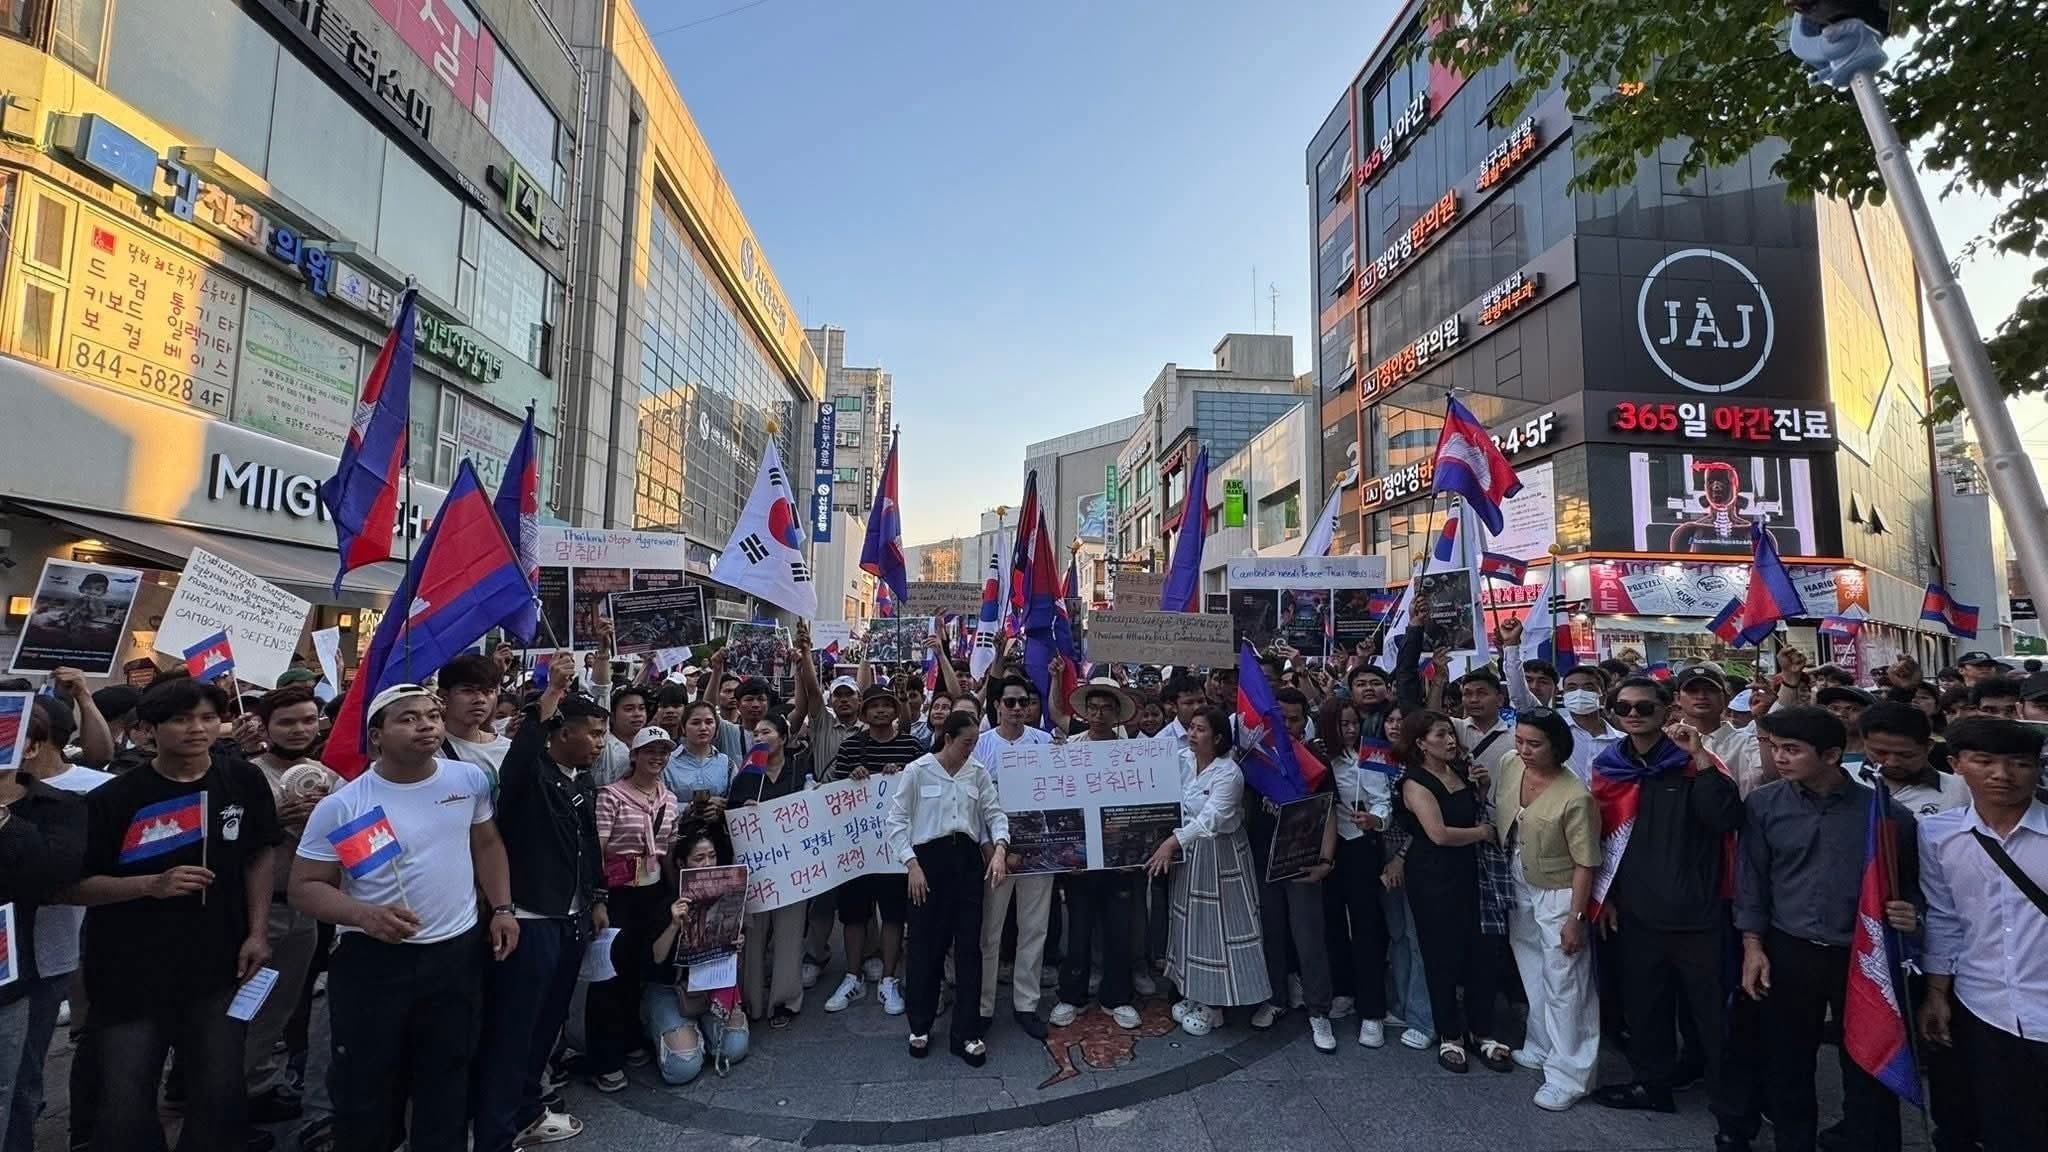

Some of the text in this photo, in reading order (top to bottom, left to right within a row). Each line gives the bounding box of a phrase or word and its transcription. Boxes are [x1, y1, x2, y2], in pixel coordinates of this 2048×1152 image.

[1396, 90, 1427, 138] 야간
[1511, 116, 1534, 146] 한방
[1376, 189, 1457, 279] 정안정한의원
[1480, 280, 1535, 326] 한방피부과
[1482, 271, 1522, 310] 한방내과
[83, 285, 232, 354] 키보드 일렉기타
[1380, 313, 1459, 388] 정안정한의원
[75, 342, 225, 407] 844-5828 4F
[1616, 402, 1707, 438] 365일
[1226, 481, 1242, 489] ABC
[1600, 564, 1619, 612] SALE
[1627, 578, 1663, 593] PRETZEL
[175, 607, 296, 652] CAMBODIA DEFENDS
[180, 589, 234, 617] THAILAND
[235, 609, 276, 630] ATTACKS
[729, 812, 765, 844] 태국
[773, 798, 810, 834] 전쟁
[800, 829, 836, 857] 평화
[790, 860, 828, 894] 먼저
[837, 846, 866, 873] 전쟁
